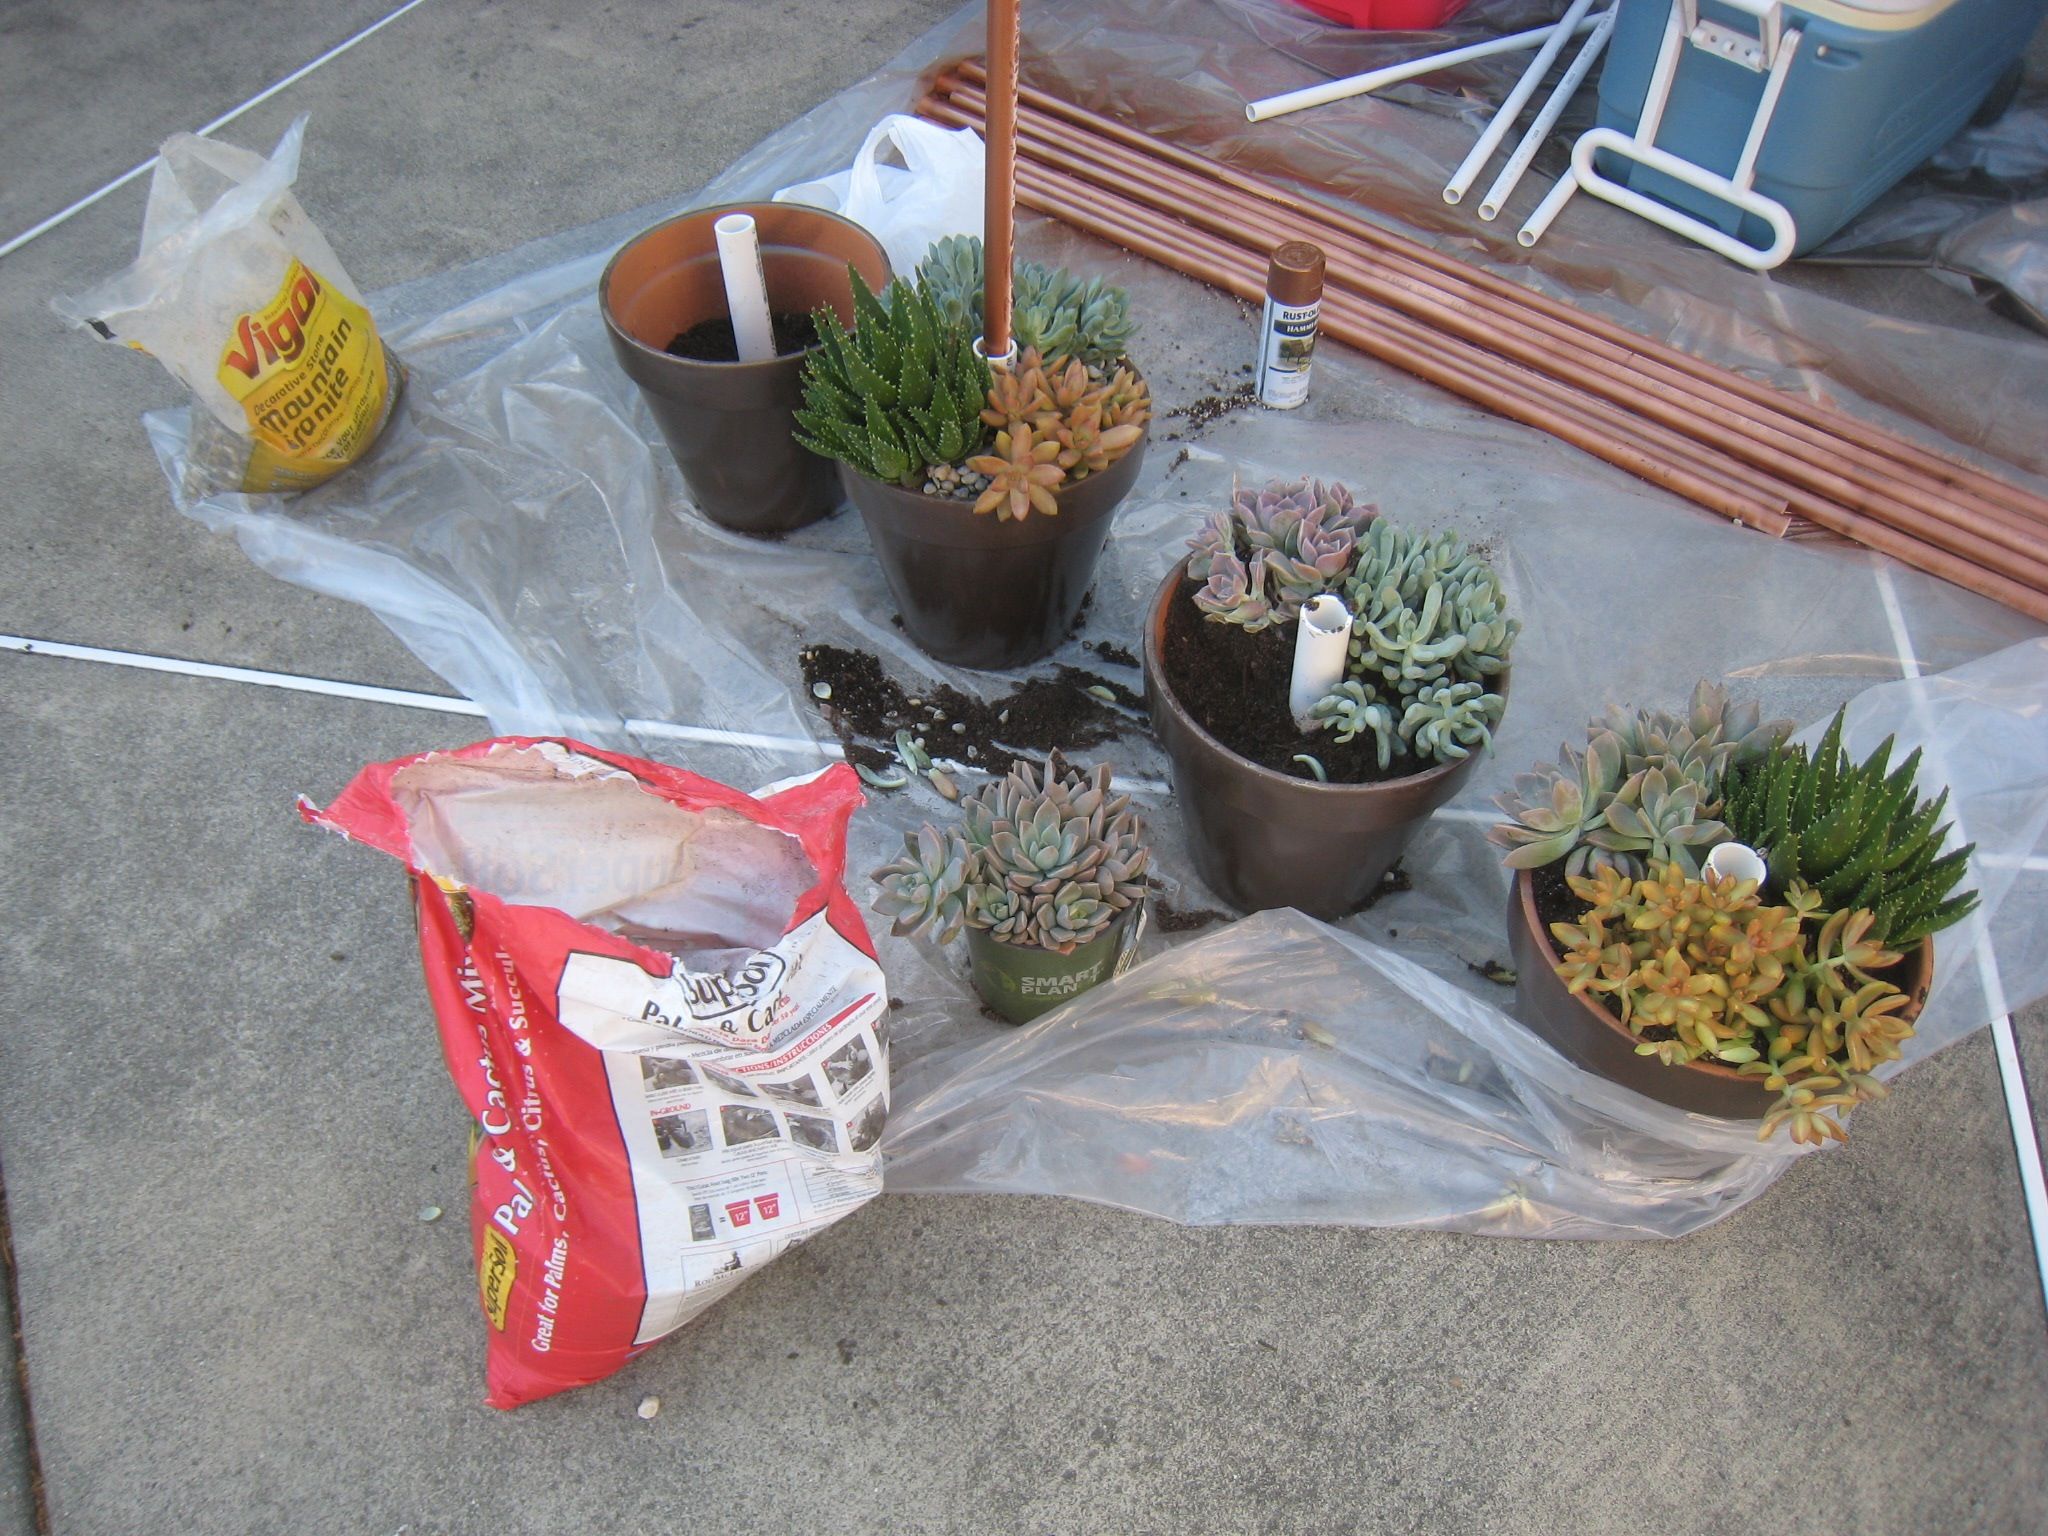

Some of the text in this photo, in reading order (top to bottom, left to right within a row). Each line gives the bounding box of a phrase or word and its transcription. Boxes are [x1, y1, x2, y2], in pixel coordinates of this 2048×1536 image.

[1283, 306, 1320, 320] RUST-OL
[254, 371, 308, 416] Decorative
[305, 334, 325, 371] Stone
[258, 318, 352, 434] Mountain
[495, 944, 529, 1030] Succul
[1021, 961, 1103, 987] SMART
[1021, 982, 1079, 996] PLAN
[514, 1037, 532, 1057] &
[735, 1022, 833, 1074] CTIONS/INSTRUCCIONES
[520, 1063, 543, 1132] Citrus
[492, 1147, 516, 1173] &
[493, 1178, 534, 1236] Pal
[486, 1230, 509, 1322] uperSoil
[544, 1230, 570, 1289] Palms,
[538, 1288, 560, 1314] for
[531, 1312, 555, 1352] Great
